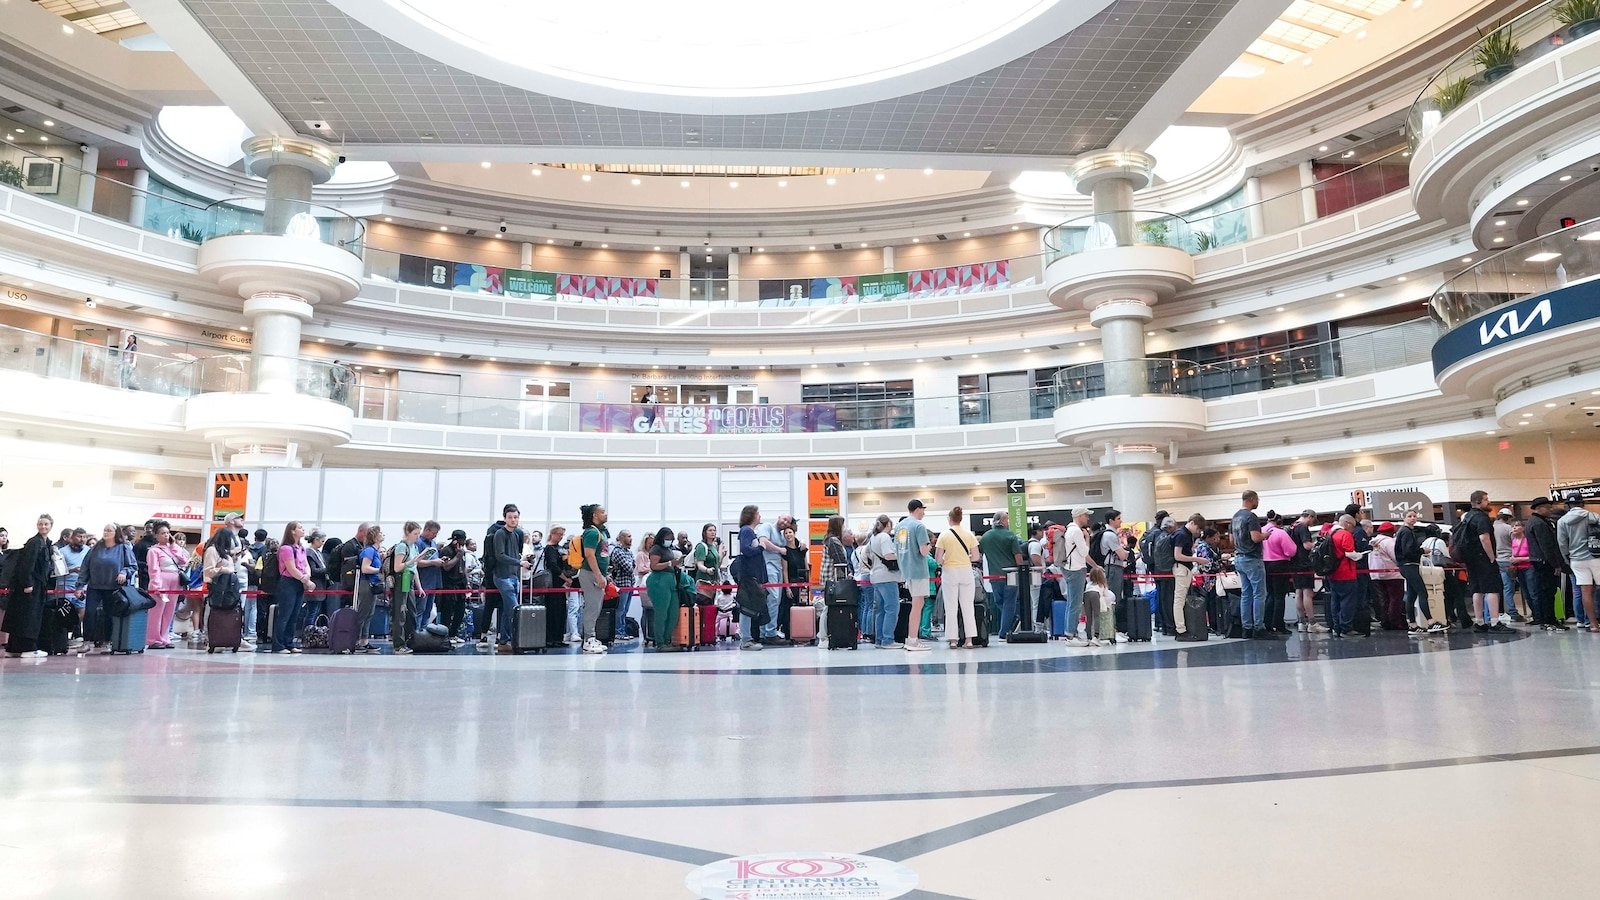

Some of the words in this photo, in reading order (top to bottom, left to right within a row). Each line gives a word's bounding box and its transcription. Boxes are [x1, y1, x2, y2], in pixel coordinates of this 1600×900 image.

[509, 280, 553, 294] WELCOME
[862, 283, 906, 296] WELCOME
[7, 290, 28, 301] USO
[1479, 299, 1553, 346] KIA
[201, 330, 228, 340] Airport
[230, 335, 252, 344] Guest
[664, 406, 706, 417] FROM
[722, 406, 785, 428] GOALS
[633, 416, 708, 433] GATES
[1388, 501, 1423, 511] KIA
[729, 859, 856, 879] 100
